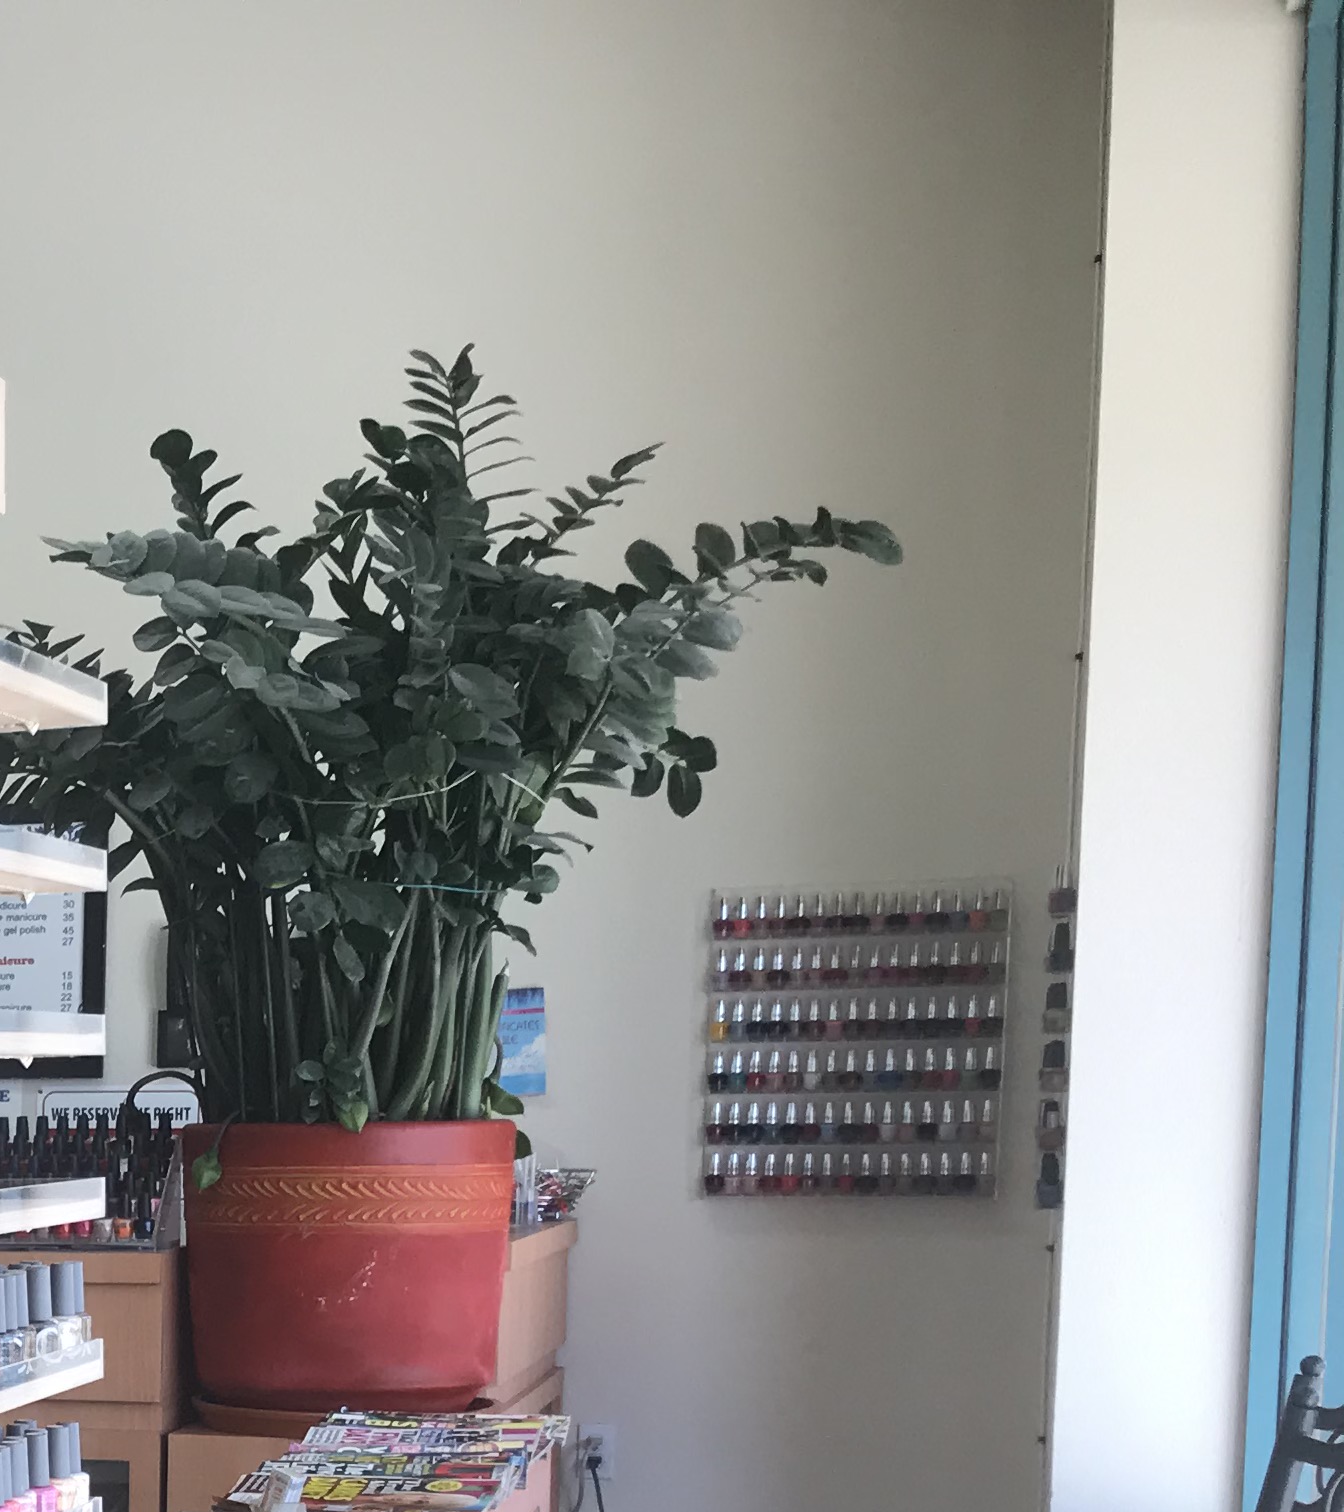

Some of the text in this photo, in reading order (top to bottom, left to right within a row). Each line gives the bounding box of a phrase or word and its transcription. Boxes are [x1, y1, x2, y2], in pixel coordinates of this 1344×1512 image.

[63, 900, 75, 909] 30
[6, 914, 47, 922] manicure
[63, 914, 74, 922] 35
[4, 926, 17, 936] gel
[20, 925, 46, 936] polish
[62, 926, 74, 935] 45
[62, 937, 74, 946] 27
[62, 971, 73, 980] 15
[62, 982, 73, 991] 18
[60, 993, 72, 1002] 22
[60, 1004, 72, 1012] 27
